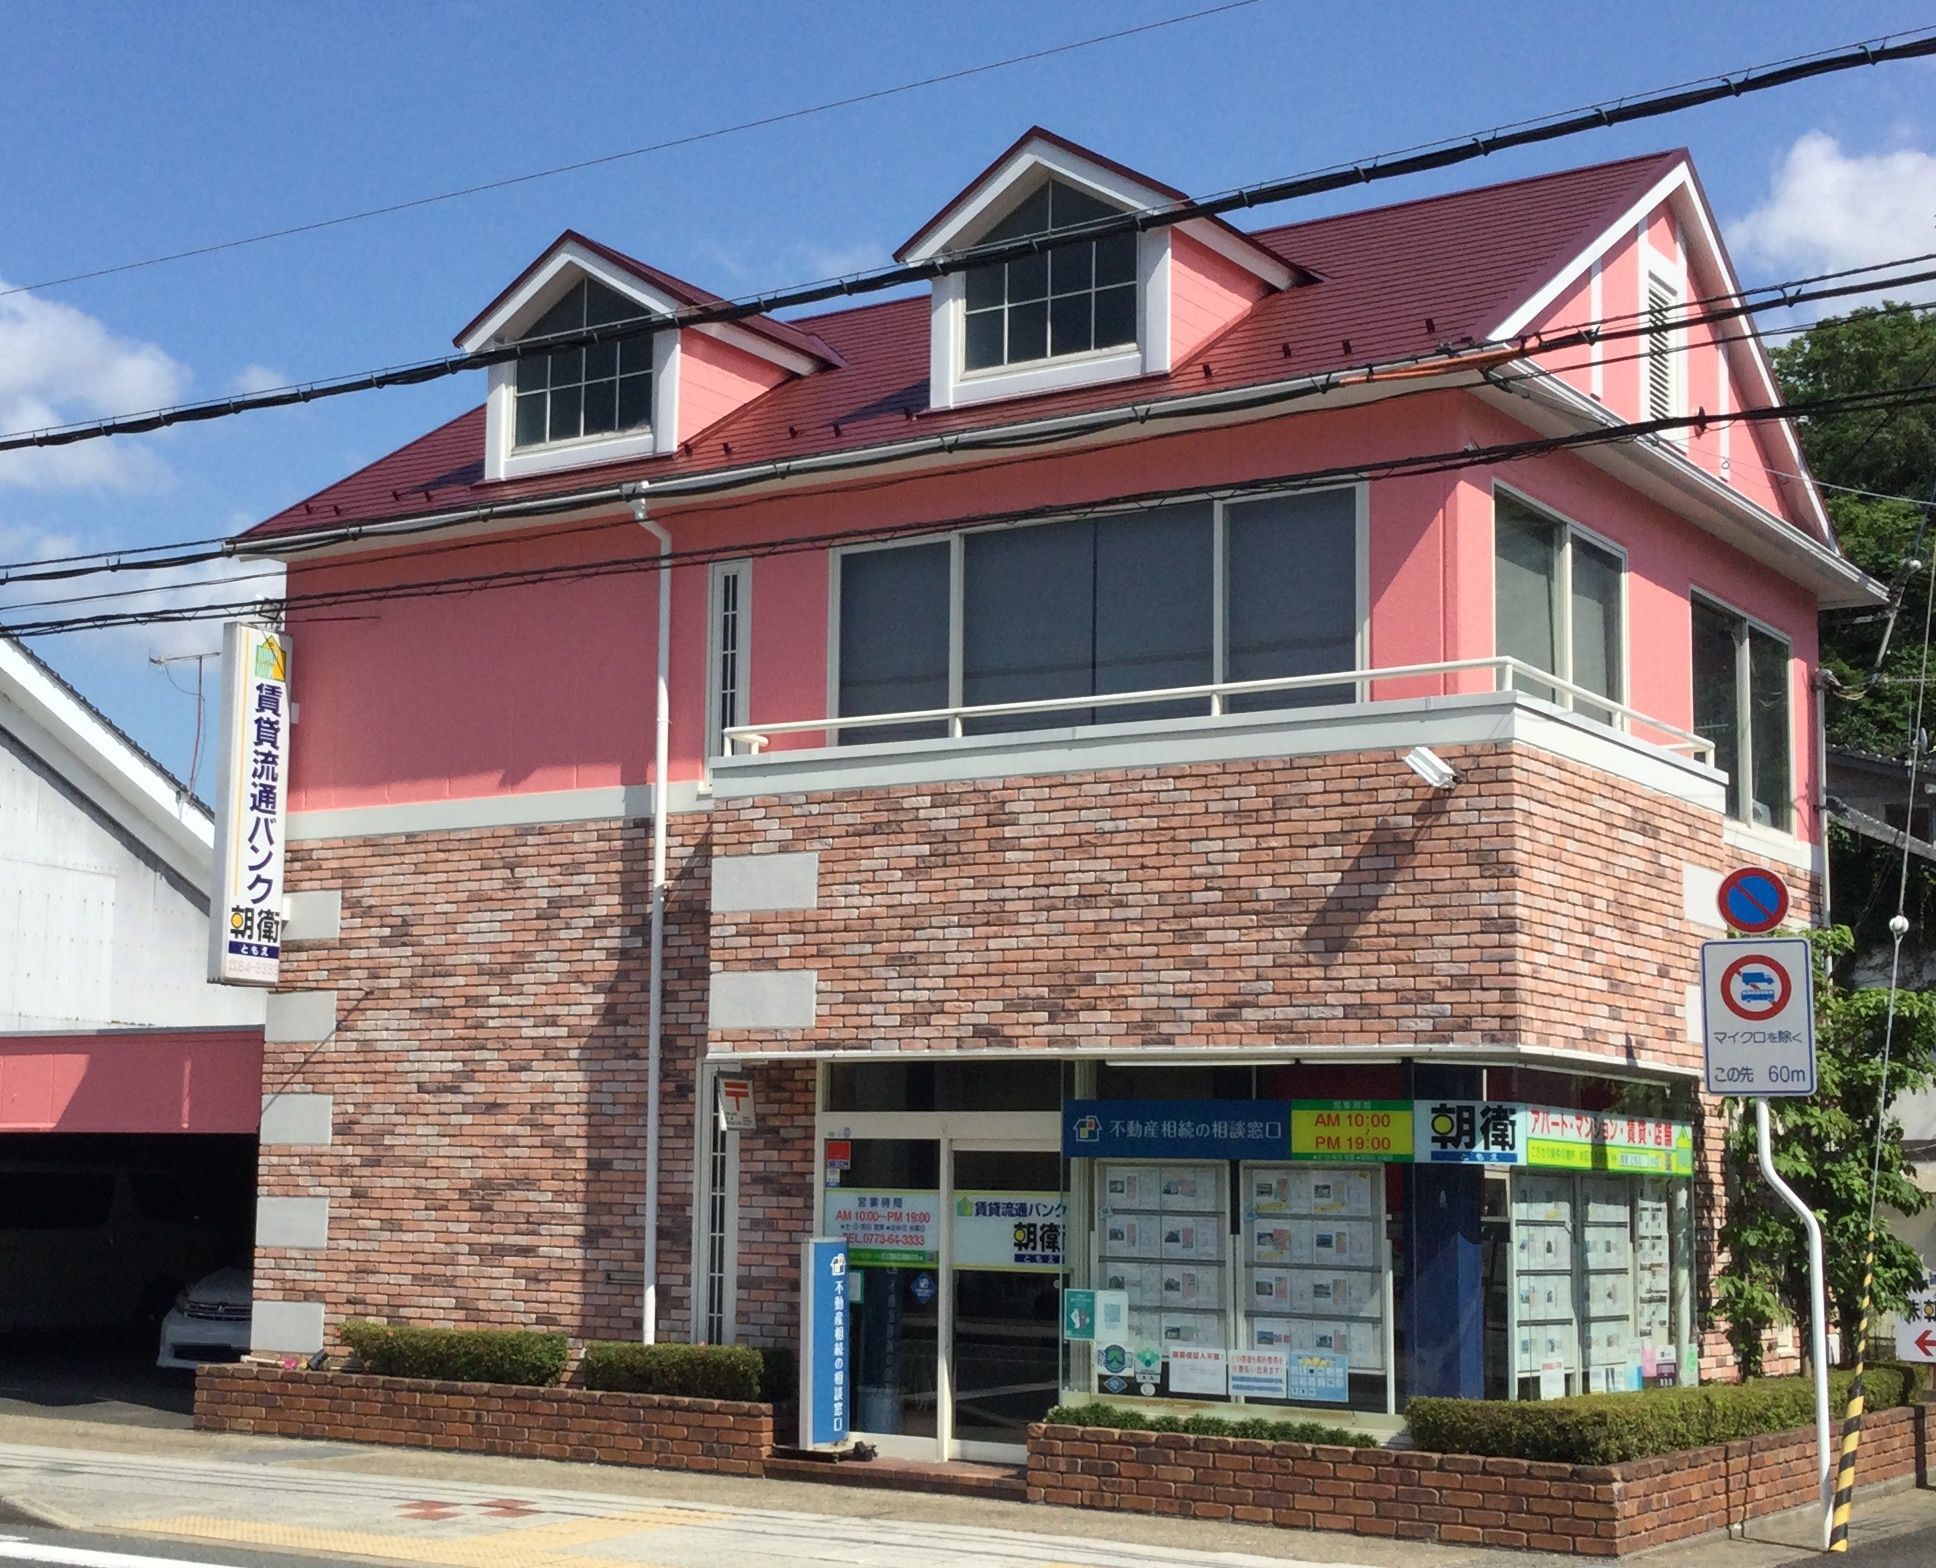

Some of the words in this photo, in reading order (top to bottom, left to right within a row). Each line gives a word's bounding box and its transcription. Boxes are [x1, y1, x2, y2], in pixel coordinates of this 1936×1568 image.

[246, 682, 283, 905] 賃貸流通バンク
[230, 905, 280, 943] 朝衛
[241, 943, 269, 957] ともえ
[1713, 1030, 1803, 1044] マイクロを除く
[1714, 1066, 1754, 1084] この先
[1768, 1065, 1806, 1083] 60m
[1109, 1119, 1282, 1140] 不動産相続の相談窓口
[1315, 1113, 1340, 1128] AM
[1347, 1113, 1391, 1128] 10:00
[1431, 1103, 1516, 1151] 朝衛
[1315, 1136, 1341, 1150] PM
[1347, 1136, 1391, 1151] 19:00
[836, 1210, 852, 1221] AM
[906, 1211, 931, 1223] 19:00
[974, 1200, 1067, 1218] 賃貸流通バンク
[1013, 1221, 1066, 1252] 朝衛
[833, 1280, 845, 1432] 不動産相続の相談窓口
